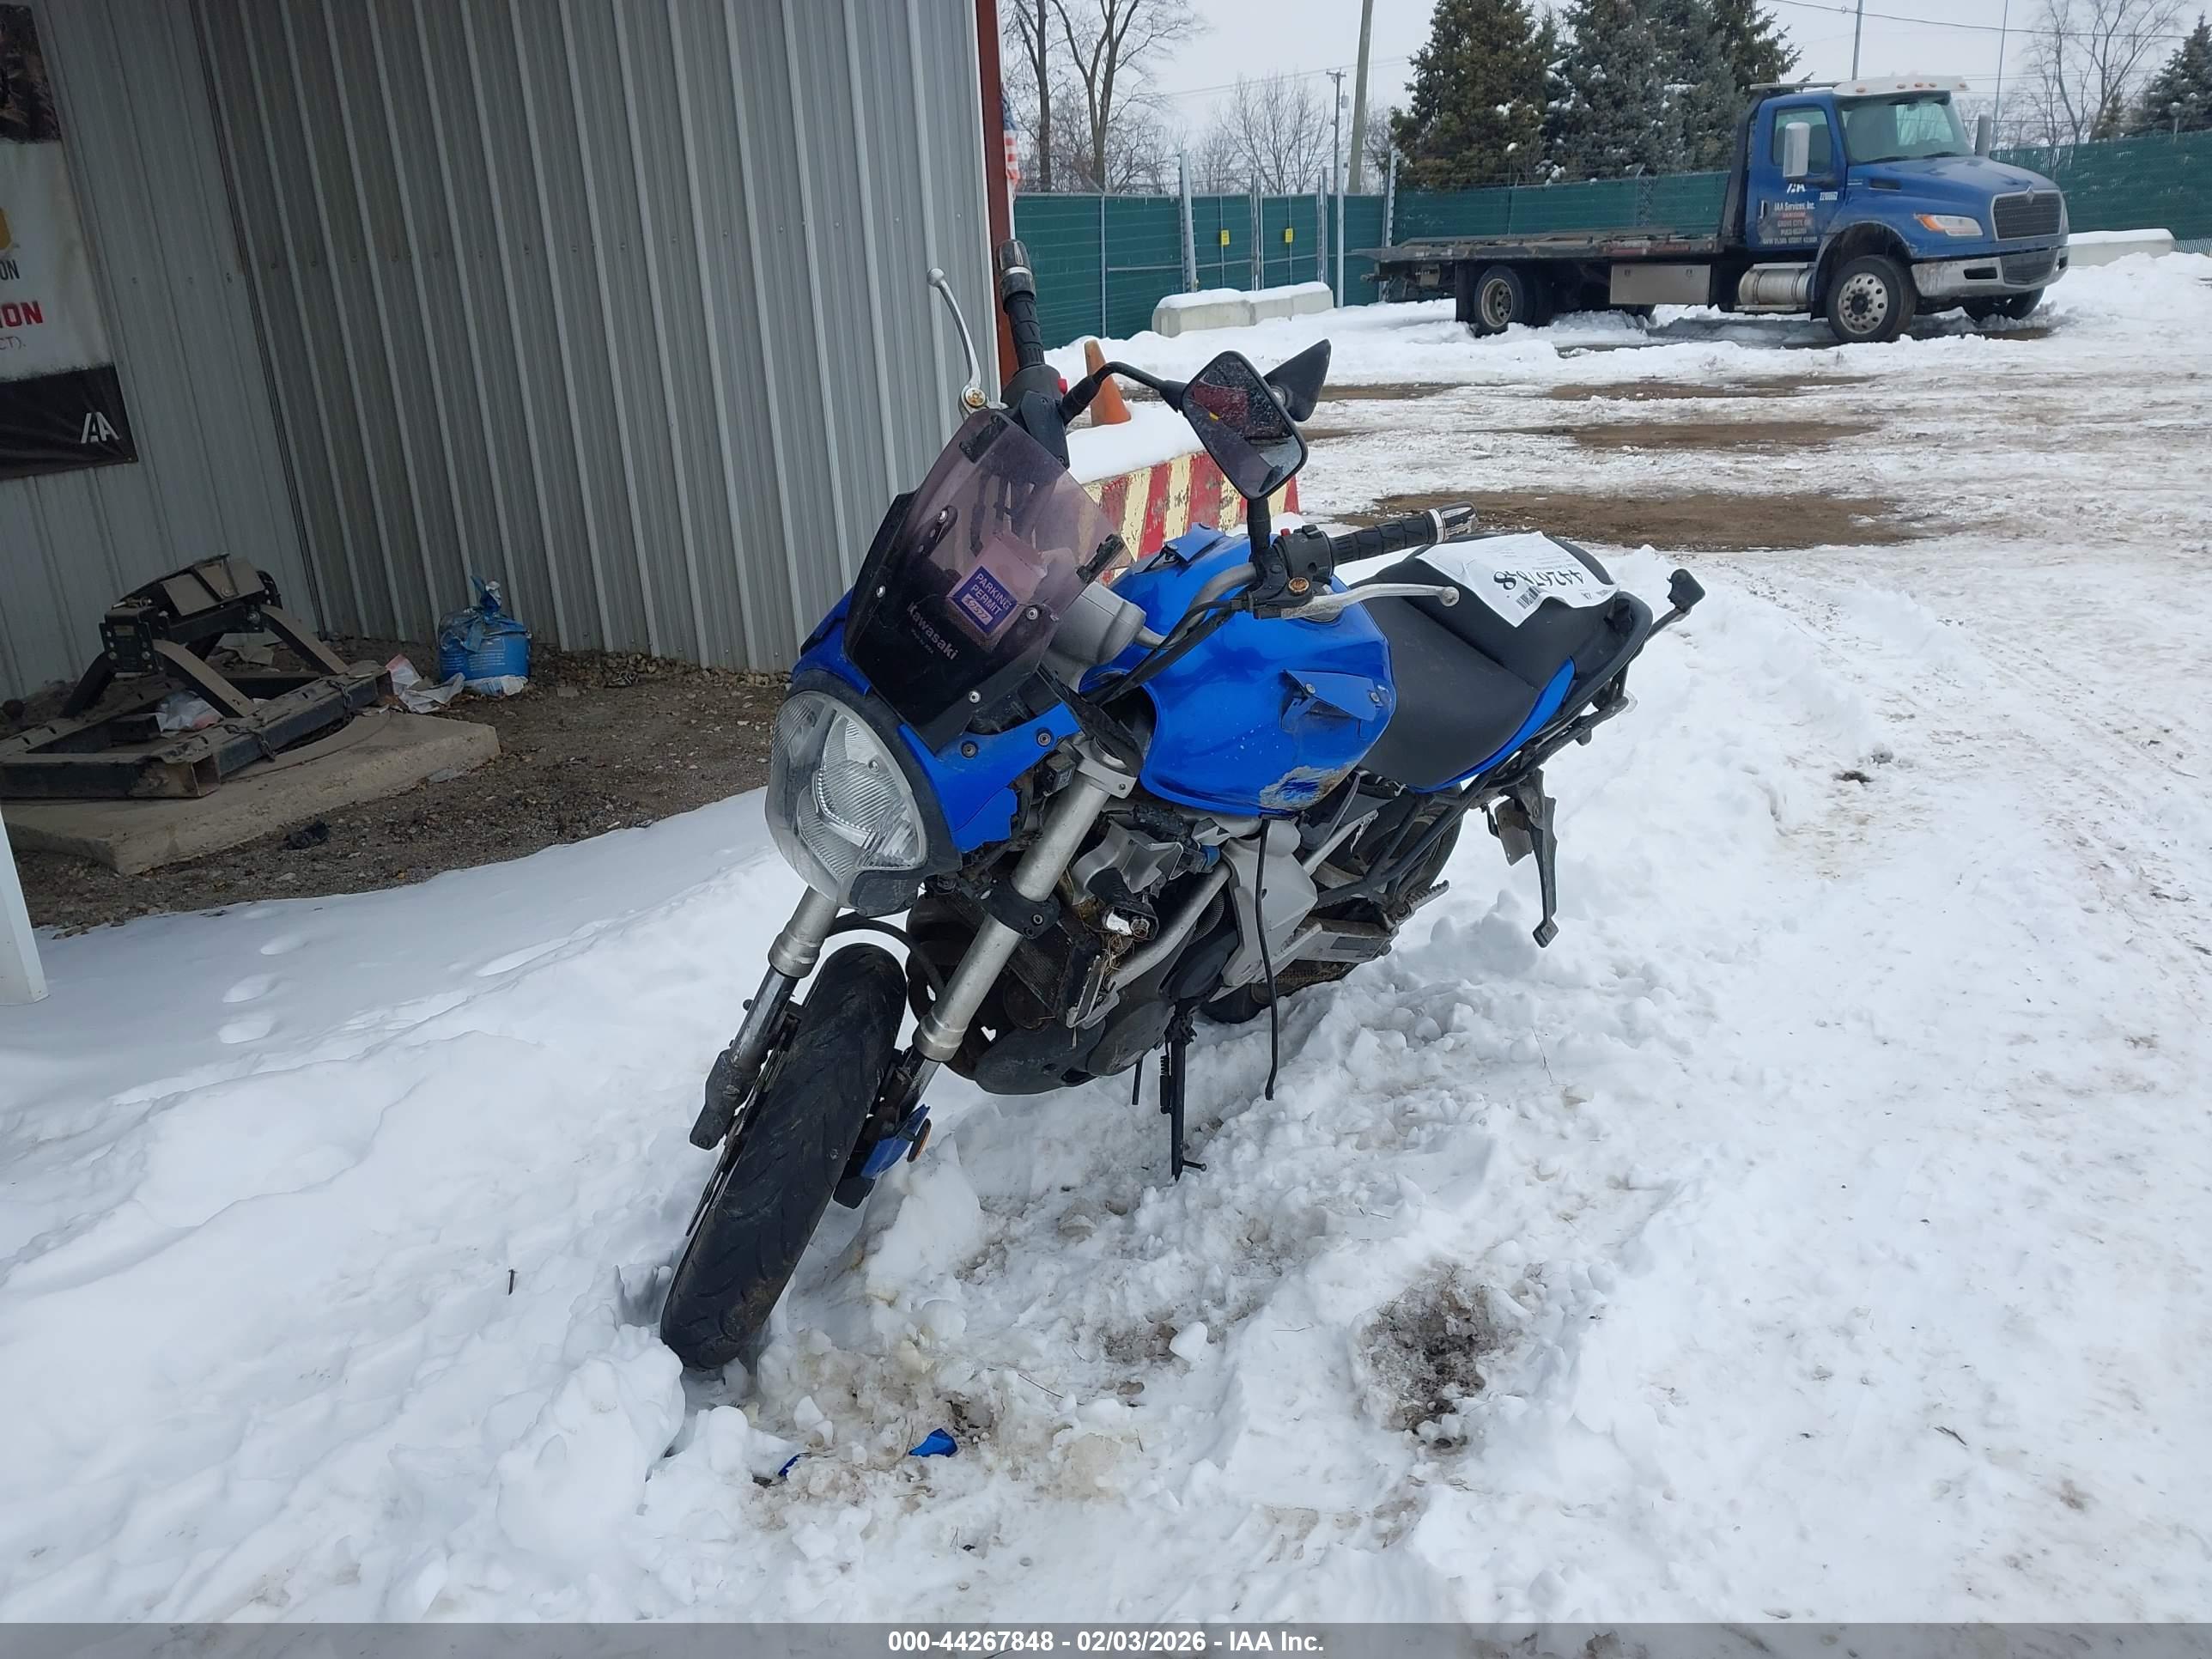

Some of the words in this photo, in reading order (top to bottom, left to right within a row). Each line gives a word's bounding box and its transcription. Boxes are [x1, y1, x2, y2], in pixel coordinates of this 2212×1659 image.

[970, 584, 1003, 615] PERMIT
[975, 573, 1013, 611] PARKING
[907, 601, 960, 660] Kawasaki
